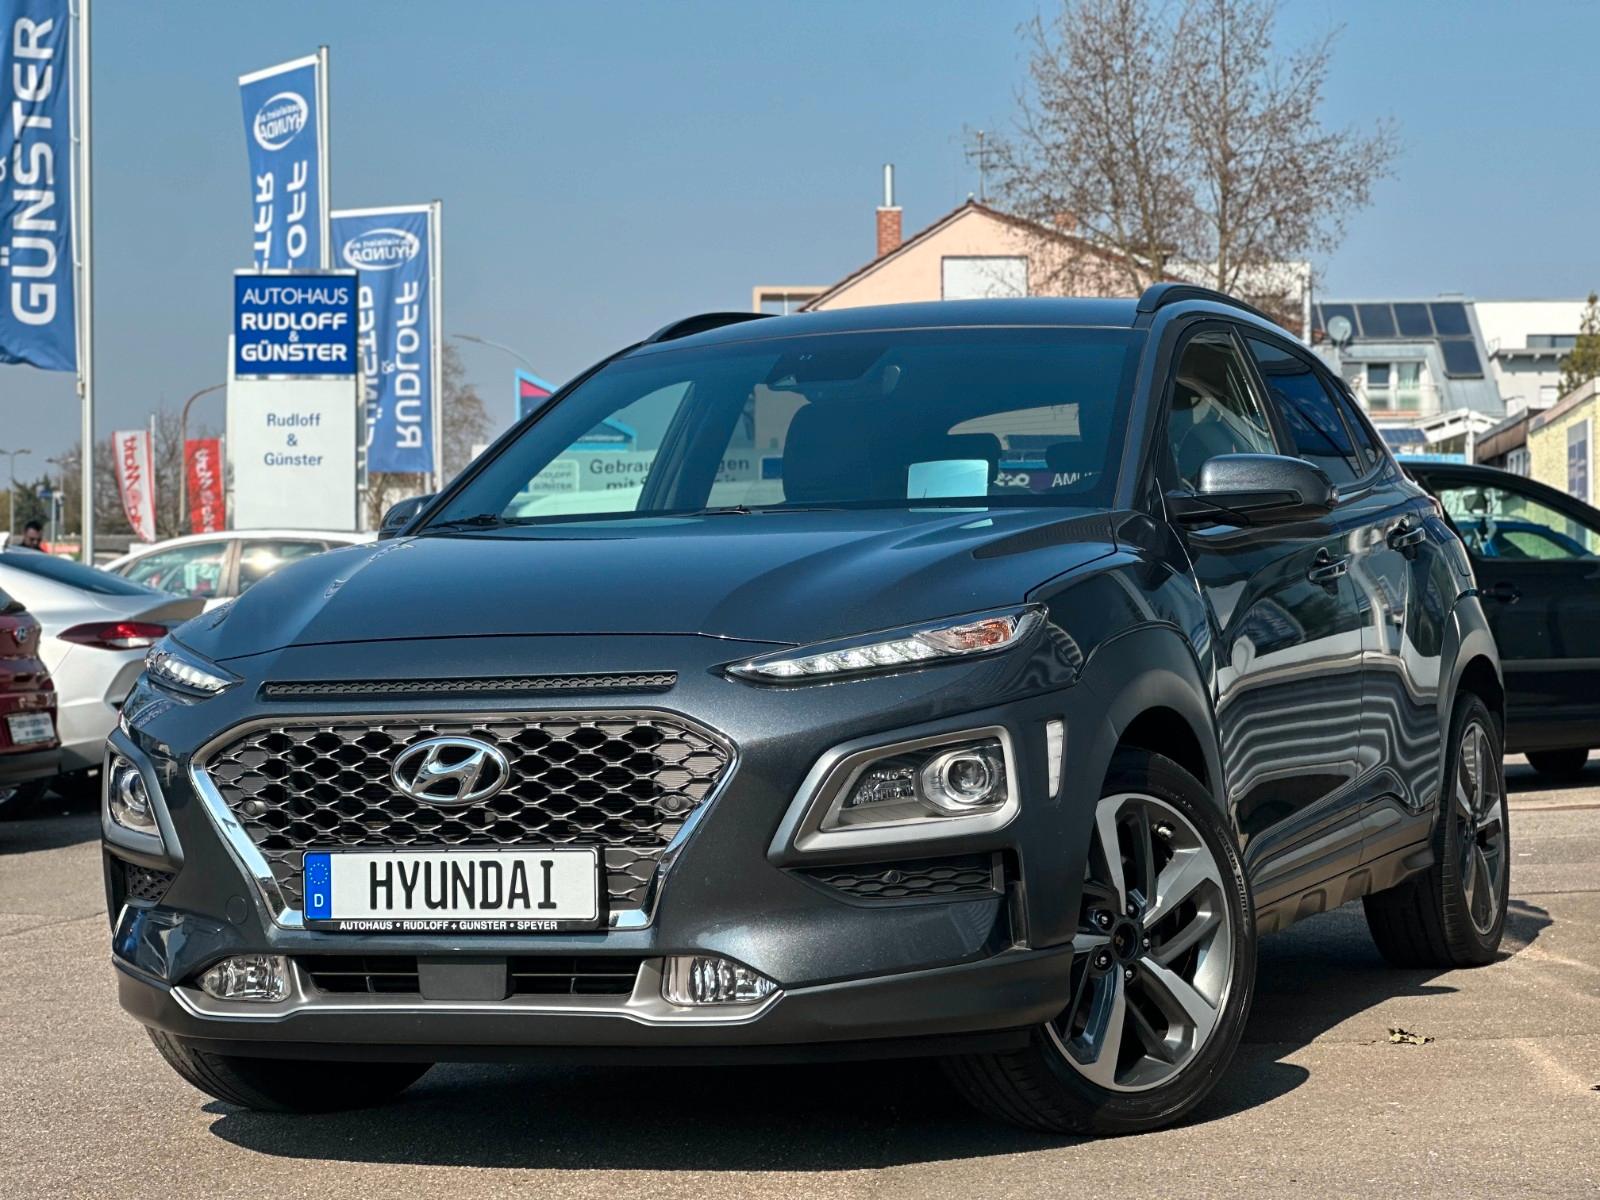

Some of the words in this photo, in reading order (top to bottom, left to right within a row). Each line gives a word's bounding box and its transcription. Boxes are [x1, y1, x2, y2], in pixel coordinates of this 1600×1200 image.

[0, 17, 57, 326] GÜNSTER
[242, 287, 348, 305] AUTOHAUS
[241, 312, 348, 331] RUDLOFF
[288, 330, 300, 343] &
[241, 340, 348, 362] GÜNSTER
[266, 413, 321, 427] Rudloff
[286, 433, 299, 447] &
[264, 452, 323, 466] Günster
[313, 893, 325, 908] D
[369, 859, 558, 911] HYUNDAI
[339, 921, 393, 931] AUTOHAUS
[403, 921, 449, 930] RUDLOFF
[517, 920, 558, 930] SPEYER
